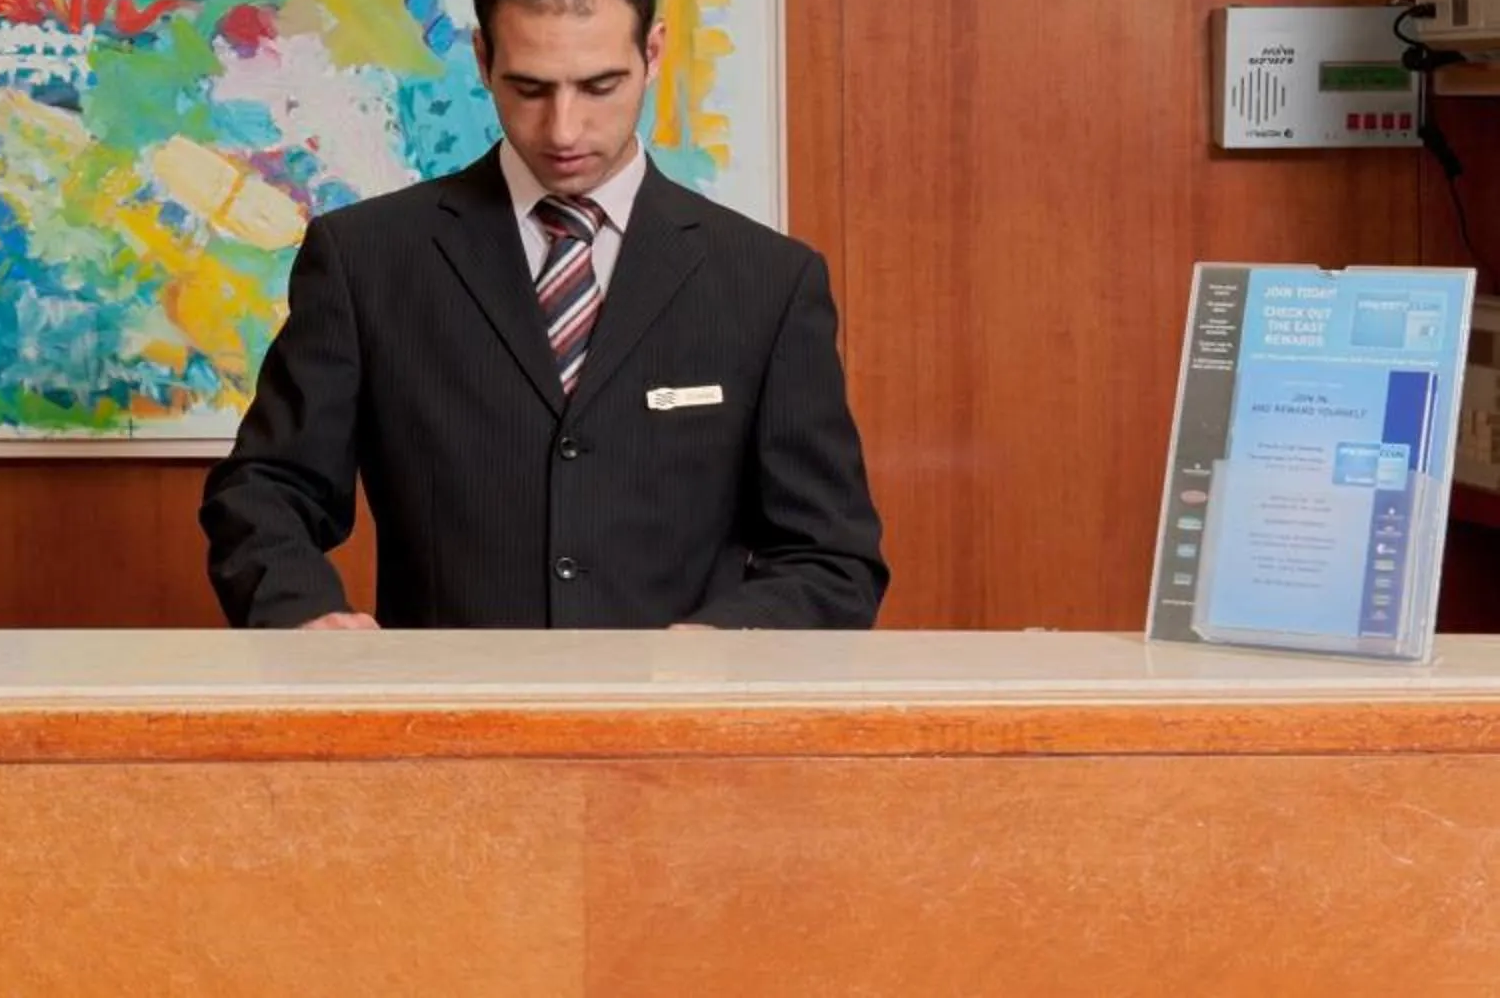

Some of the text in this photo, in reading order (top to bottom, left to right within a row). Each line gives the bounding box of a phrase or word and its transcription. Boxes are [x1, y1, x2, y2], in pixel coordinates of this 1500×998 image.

[1263, 287, 1293, 299] JOIN
[1263, 306, 1332, 320] CHECK OUT
[1267, 320, 1291, 332] THE
